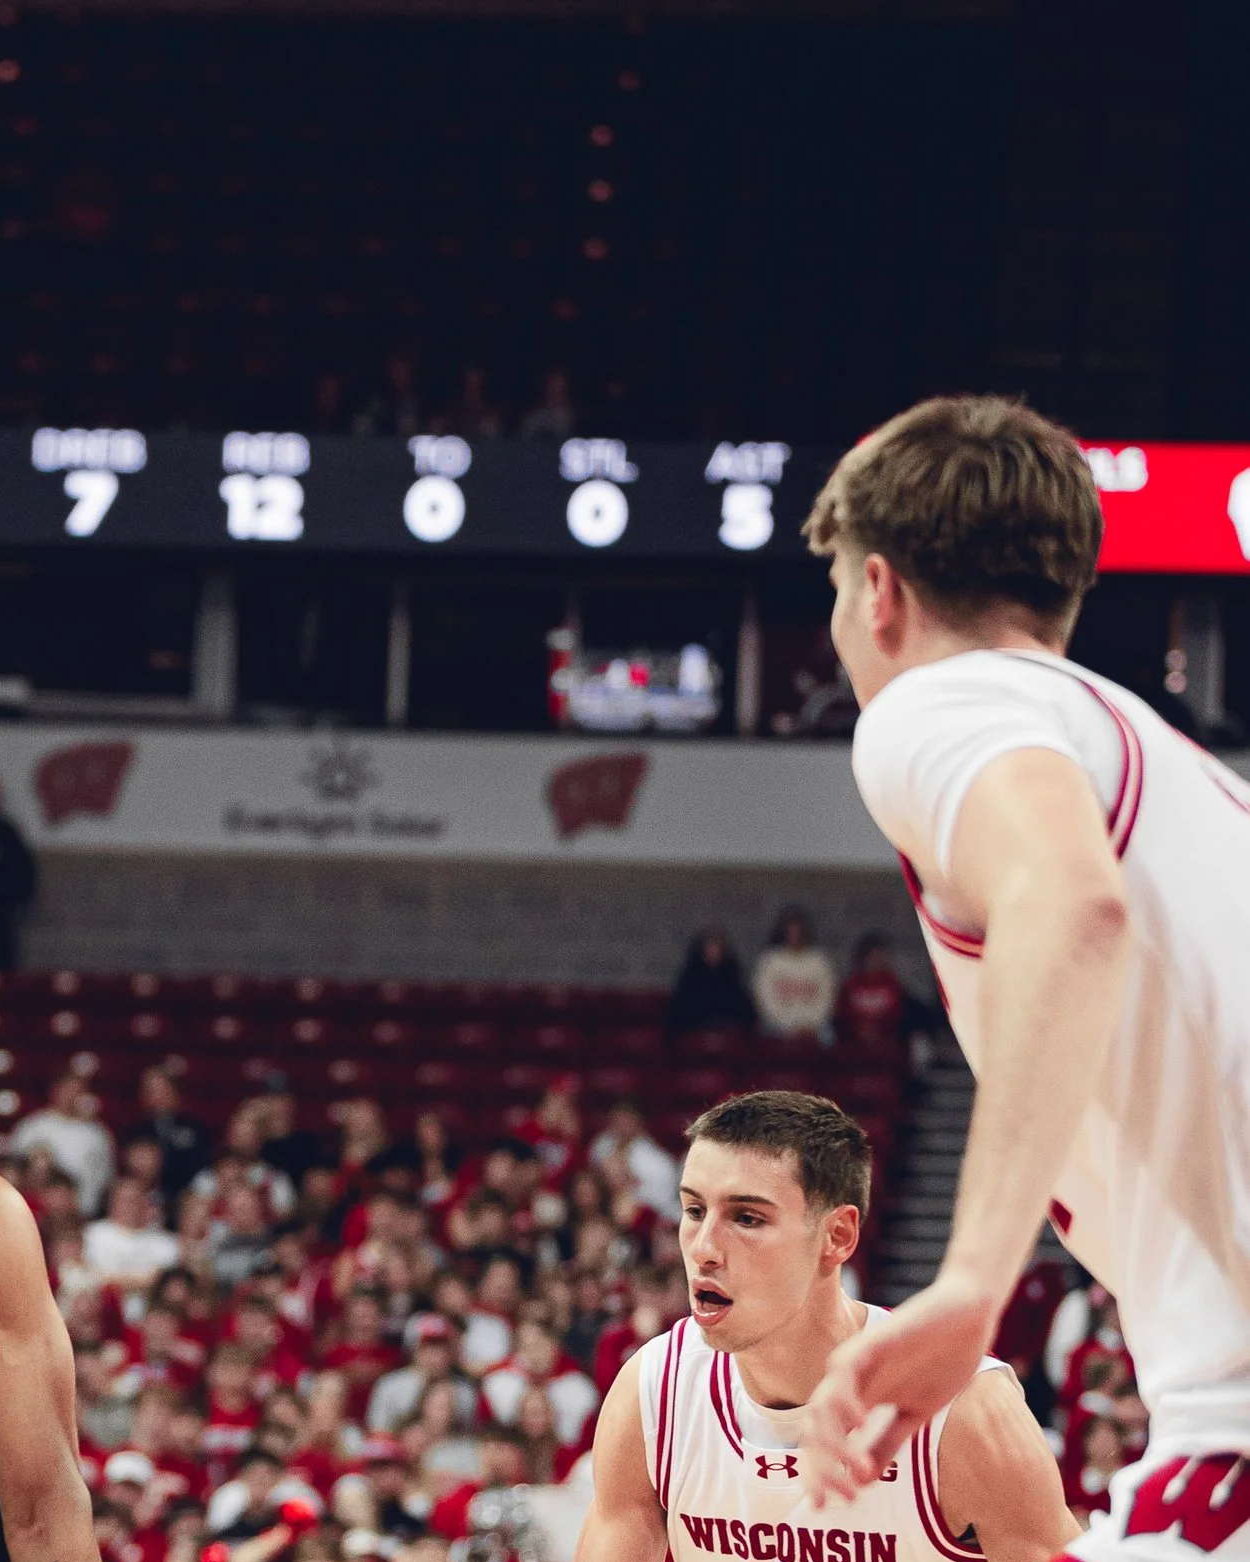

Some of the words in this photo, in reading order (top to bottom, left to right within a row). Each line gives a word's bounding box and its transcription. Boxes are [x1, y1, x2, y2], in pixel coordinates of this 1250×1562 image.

[222, 431, 310, 477] REB
[408, 435, 472, 482] TO
[559, 437, 639, 483] STL
[705, 441, 792, 485] AST
[64, 469, 119, 537] 7
[219, 473, 305, 541] 12
[403, 474, 466, 543] 0
[566, 479, 629, 548] 0
[719, 481, 774, 551] 5
